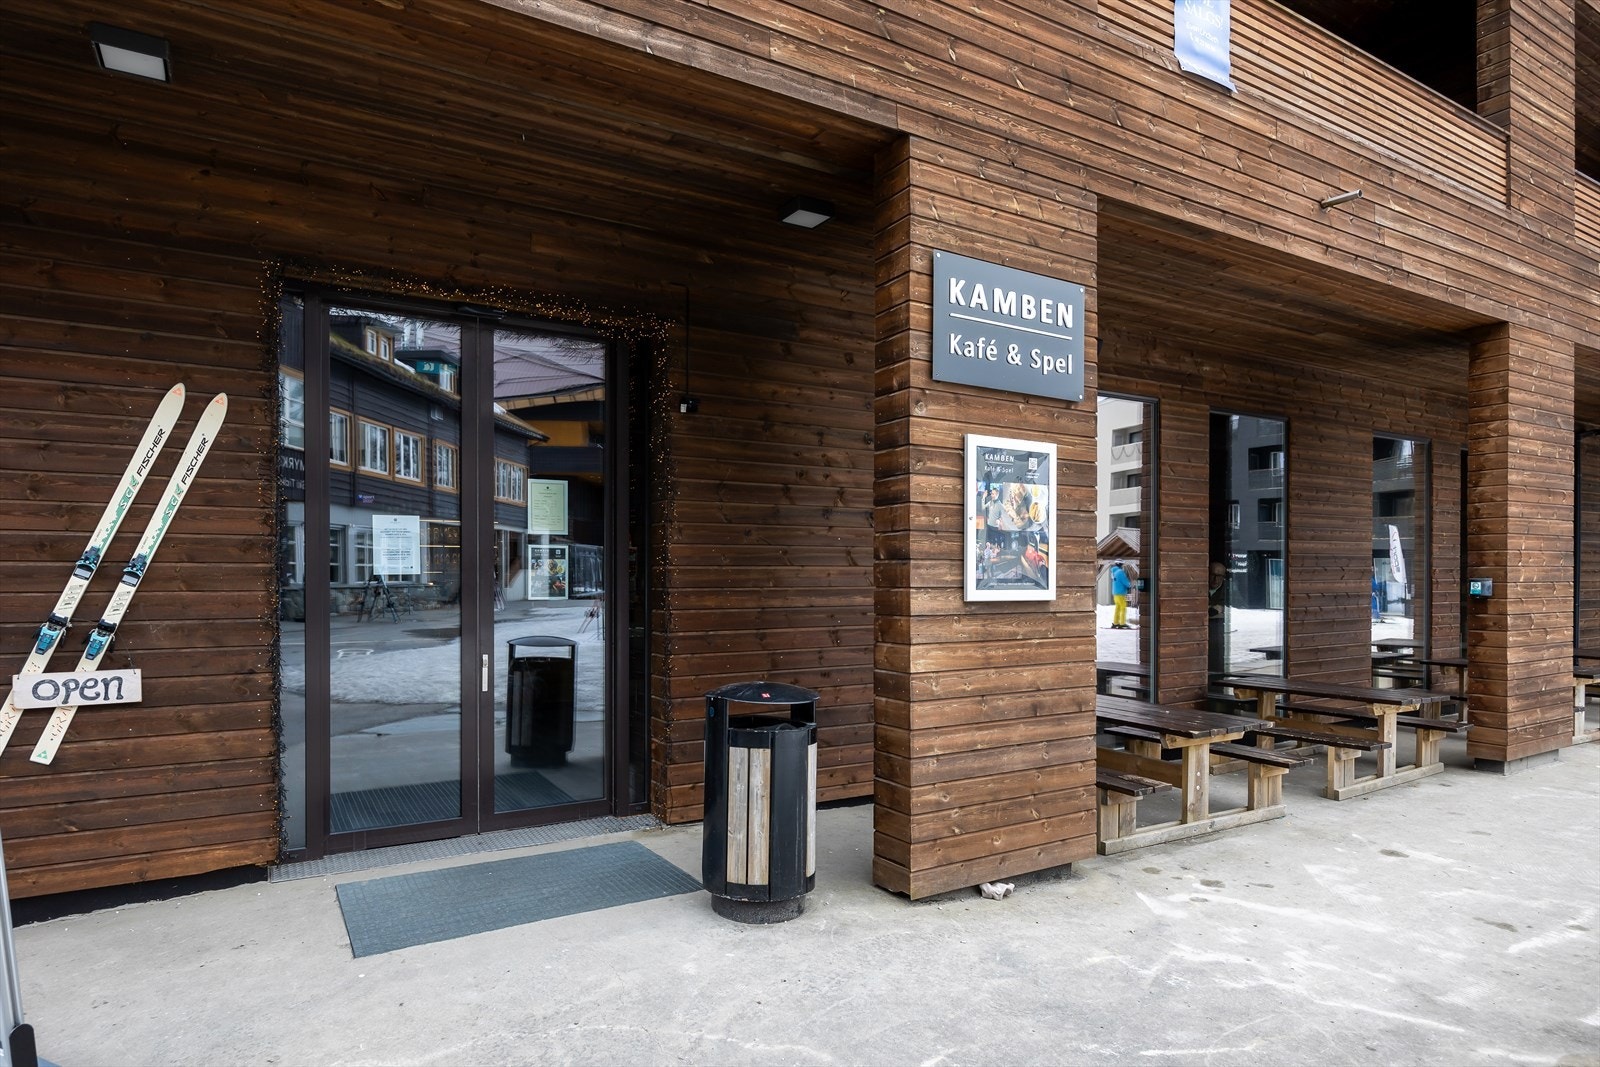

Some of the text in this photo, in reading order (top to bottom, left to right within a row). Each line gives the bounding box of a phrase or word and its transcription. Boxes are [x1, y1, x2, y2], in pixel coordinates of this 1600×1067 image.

[949, 277, 1073, 329] KAMBEN
[949, 333, 1073, 375] Kafé & Spel
[137, 428, 166, 478] FISCHER
[181, 438, 209, 484] FISCHER
[985, 453, 1015, 462] KAMBEN
